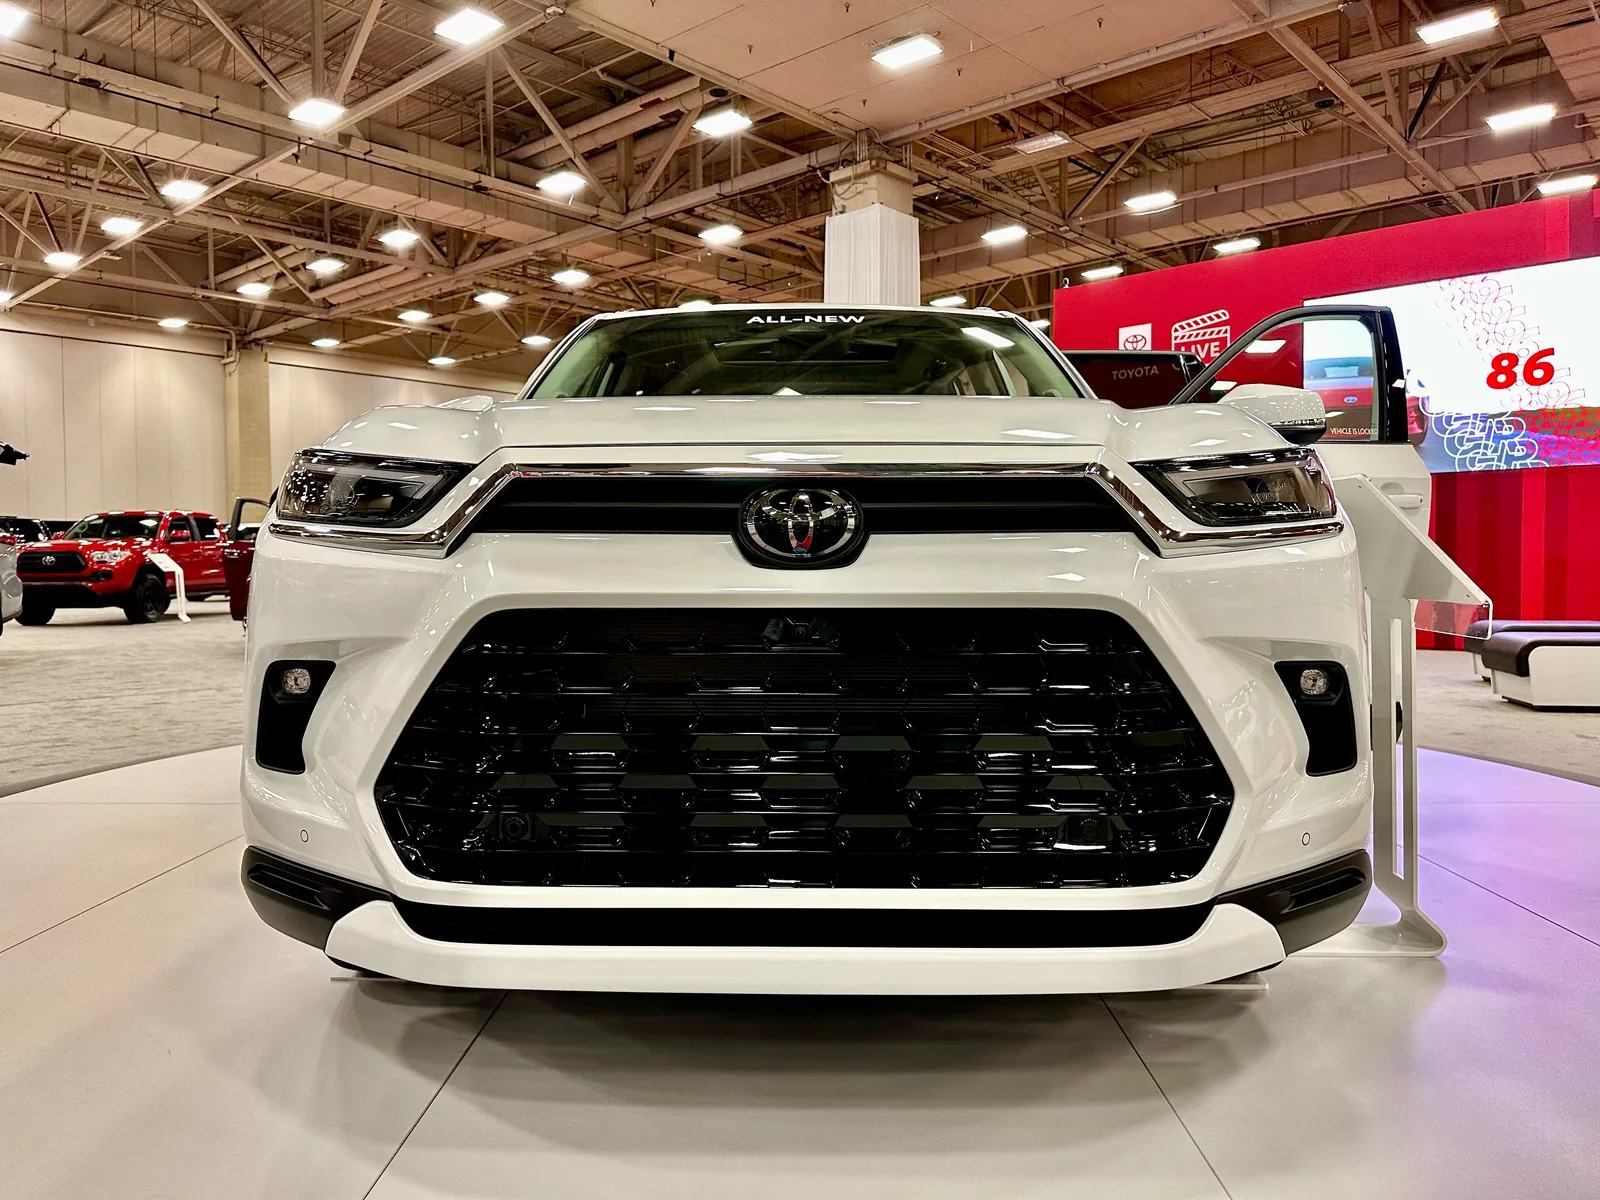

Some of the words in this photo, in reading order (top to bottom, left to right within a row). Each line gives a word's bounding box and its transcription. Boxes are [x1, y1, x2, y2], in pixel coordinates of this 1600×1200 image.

[746, 315, 865, 324] ALL-NEW
[1112, 365, 1159, 380] TOYOTA
[1486, 347, 1555, 390] 86
[1330, 427, 1352, 435] VEHICLE
[1352, 427, 1357, 435] IS
[1357, 427, 1378, 435] LOCKED
